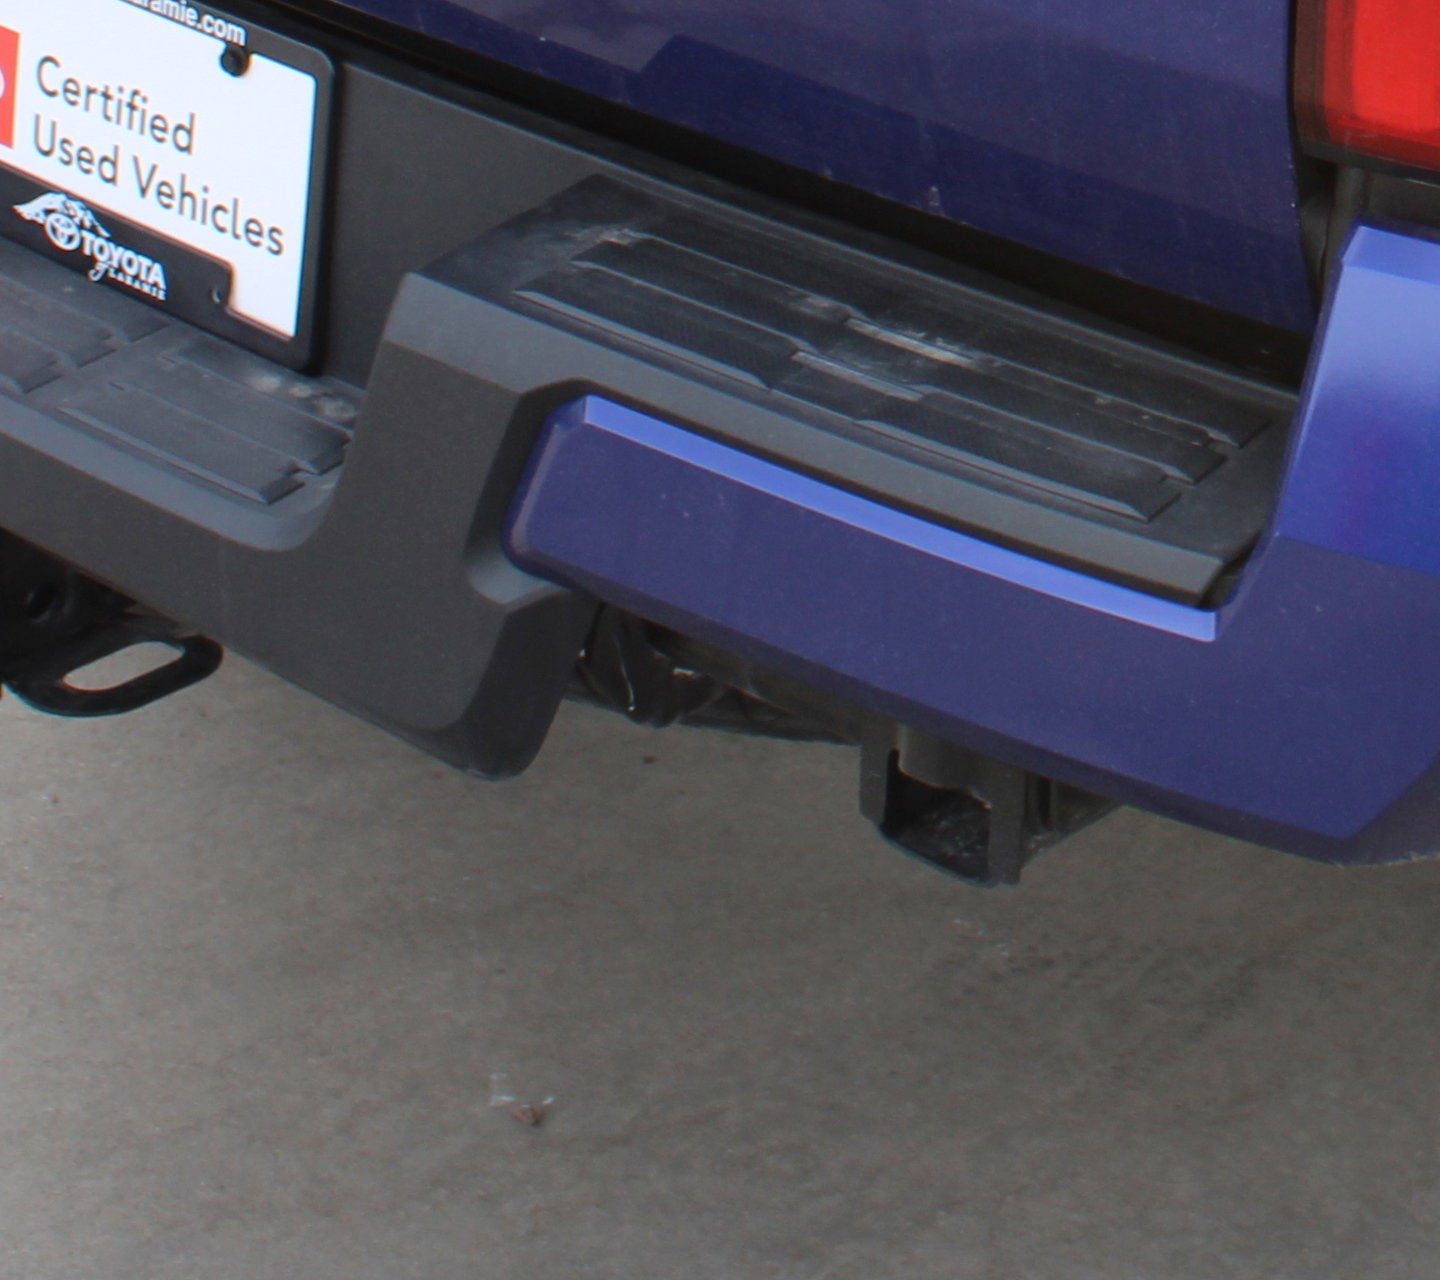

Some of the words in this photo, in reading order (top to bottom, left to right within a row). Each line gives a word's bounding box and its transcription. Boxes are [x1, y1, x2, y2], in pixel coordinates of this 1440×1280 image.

[35, 54, 197, 156] Certified
[32, 112, 121, 187] Used
[131, 153, 286, 257] Vehicles
[79, 228, 168, 291] TOYOTA
[109, 266, 167, 301] LARAMIE
